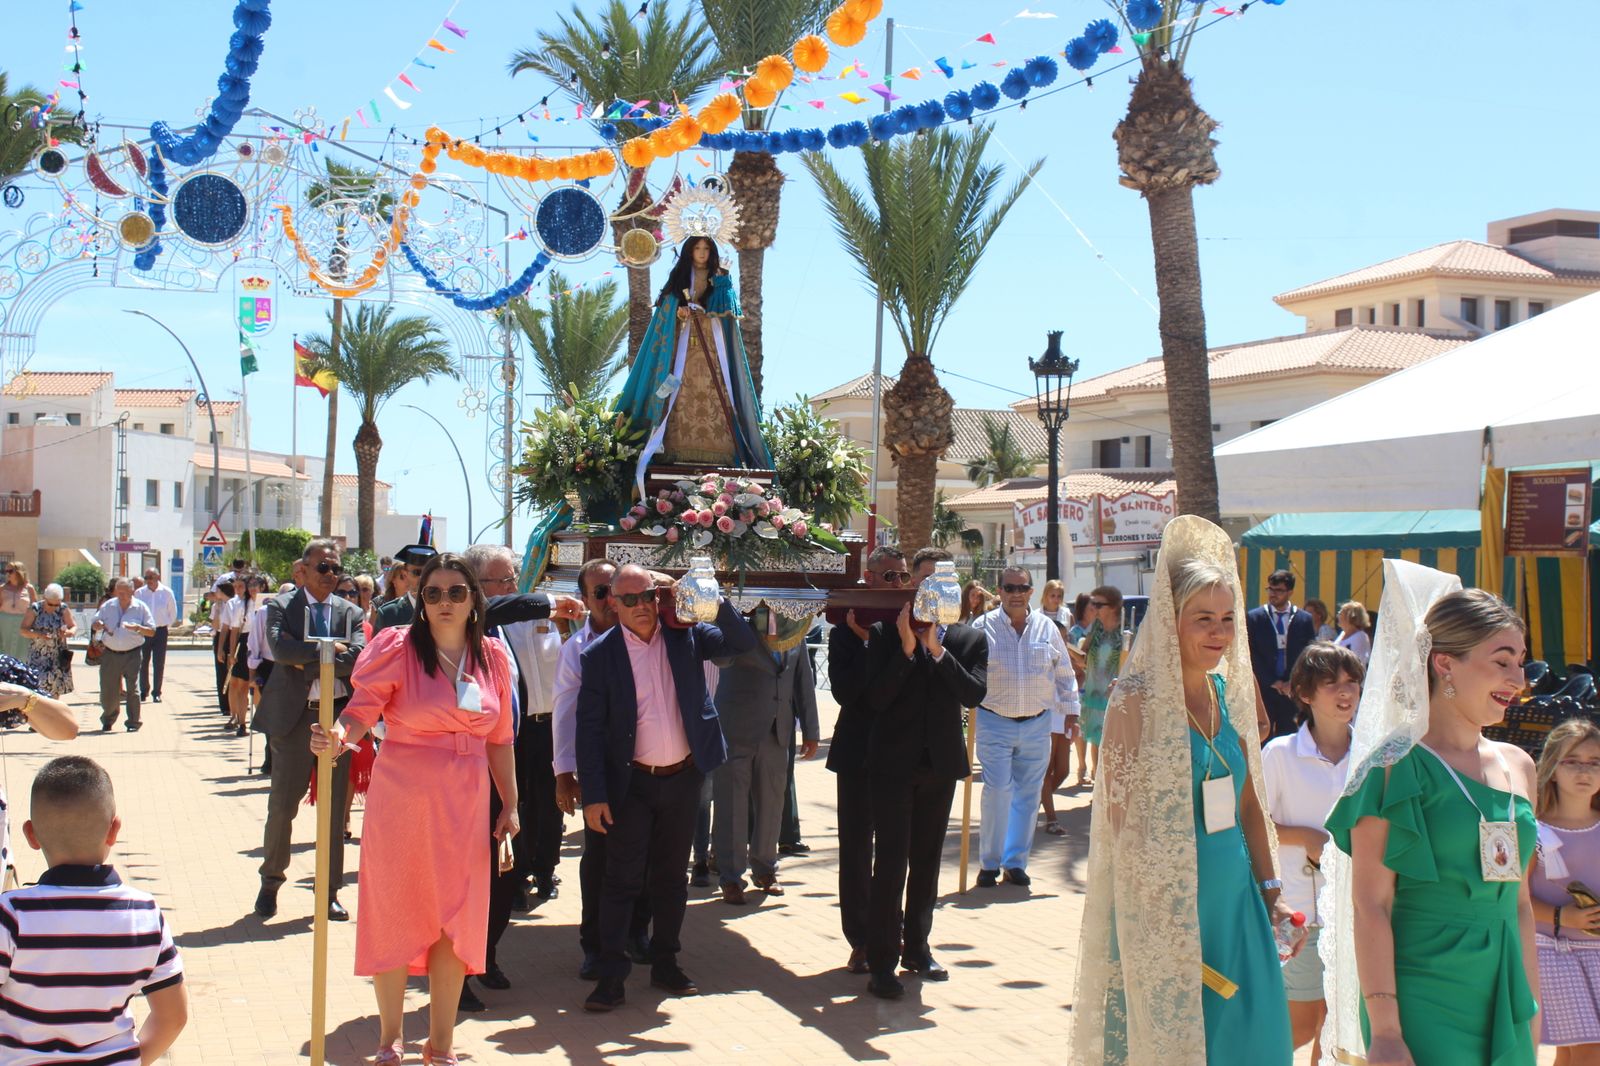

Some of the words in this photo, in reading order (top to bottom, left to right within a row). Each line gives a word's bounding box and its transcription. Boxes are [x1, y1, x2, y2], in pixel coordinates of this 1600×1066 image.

[1022, 510, 1034, 527] EL
[1036, 504, 1084, 522] SATERO
[1103, 506, 1118, 518] EL
[1120, 500, 1172, 514] SANTERO
[1108, 534, 1139, 542] TURRONES
